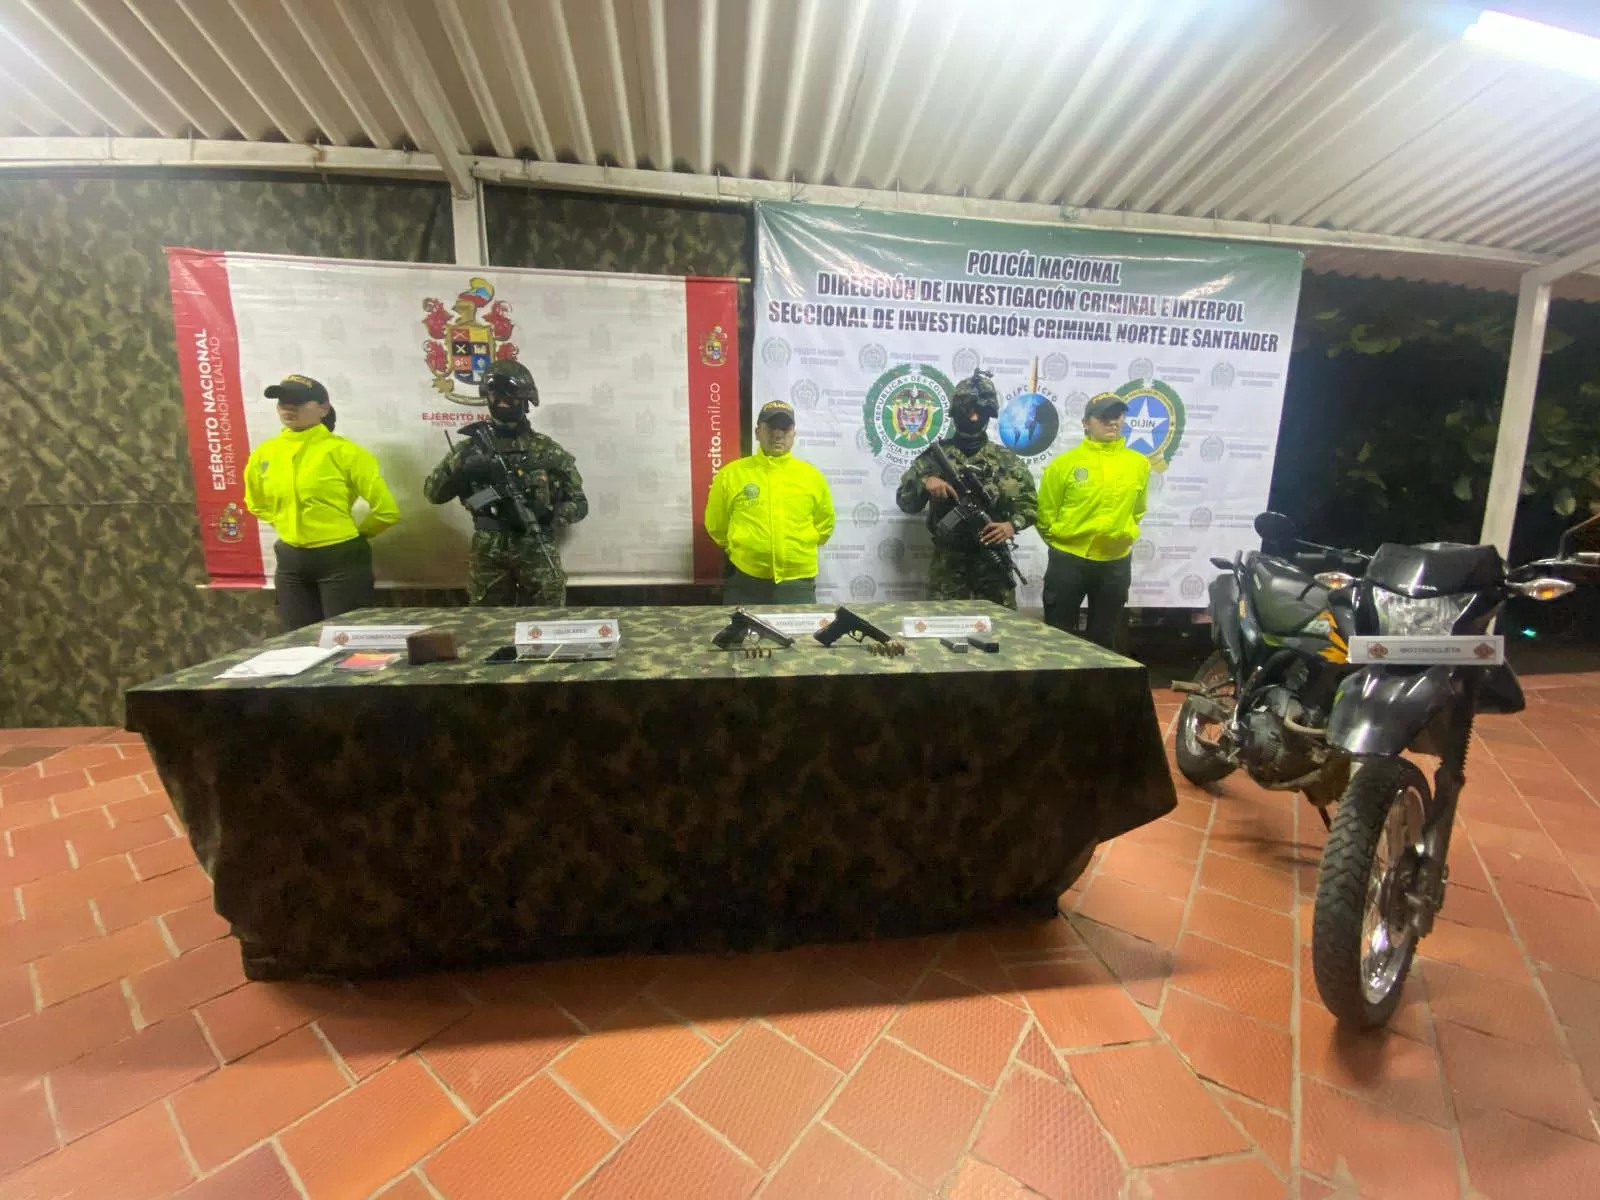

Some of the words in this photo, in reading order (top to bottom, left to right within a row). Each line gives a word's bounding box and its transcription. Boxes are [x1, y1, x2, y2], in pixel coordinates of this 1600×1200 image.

[968, 250, 1037, 277] POLICÍA
[1040, 258, 1120, 284] NACIONAL
[818, 272, 917, 301] DIRECCIÓN
[920, 279, 942, 302] DE
[946, 281, 1076, 311] INVESTIGACIÓN
[1080, 291, 1157, 317] CRIMINAL
[1160, 296, 1169, 318] E
[1171, 299, 1244, 322] INTERPOL
[769, 302, 868, 328] SECCIONAL
[872, 308, 895, 330] DE
[899, 311, 1030, 337] INVESTIGACIÓN
[1033, 318, 1112, 341] CRIMINAL
[1116, 322, 1166, 345] NORTE
[1169, 326, 1189, 346] DE
[1191, 328, 1279, 352] SANTANDER
[195, 328, 217, 413] NACIONAL
[209, 336, 226, 391] LEALTAD
[216, 394, 232, 441] HONOR
[1130, 418, 1155, 429] DIJIN
[206, 416, 226, 490] EJÉRCITO
[223, 444, 237, 485] PATRIA
